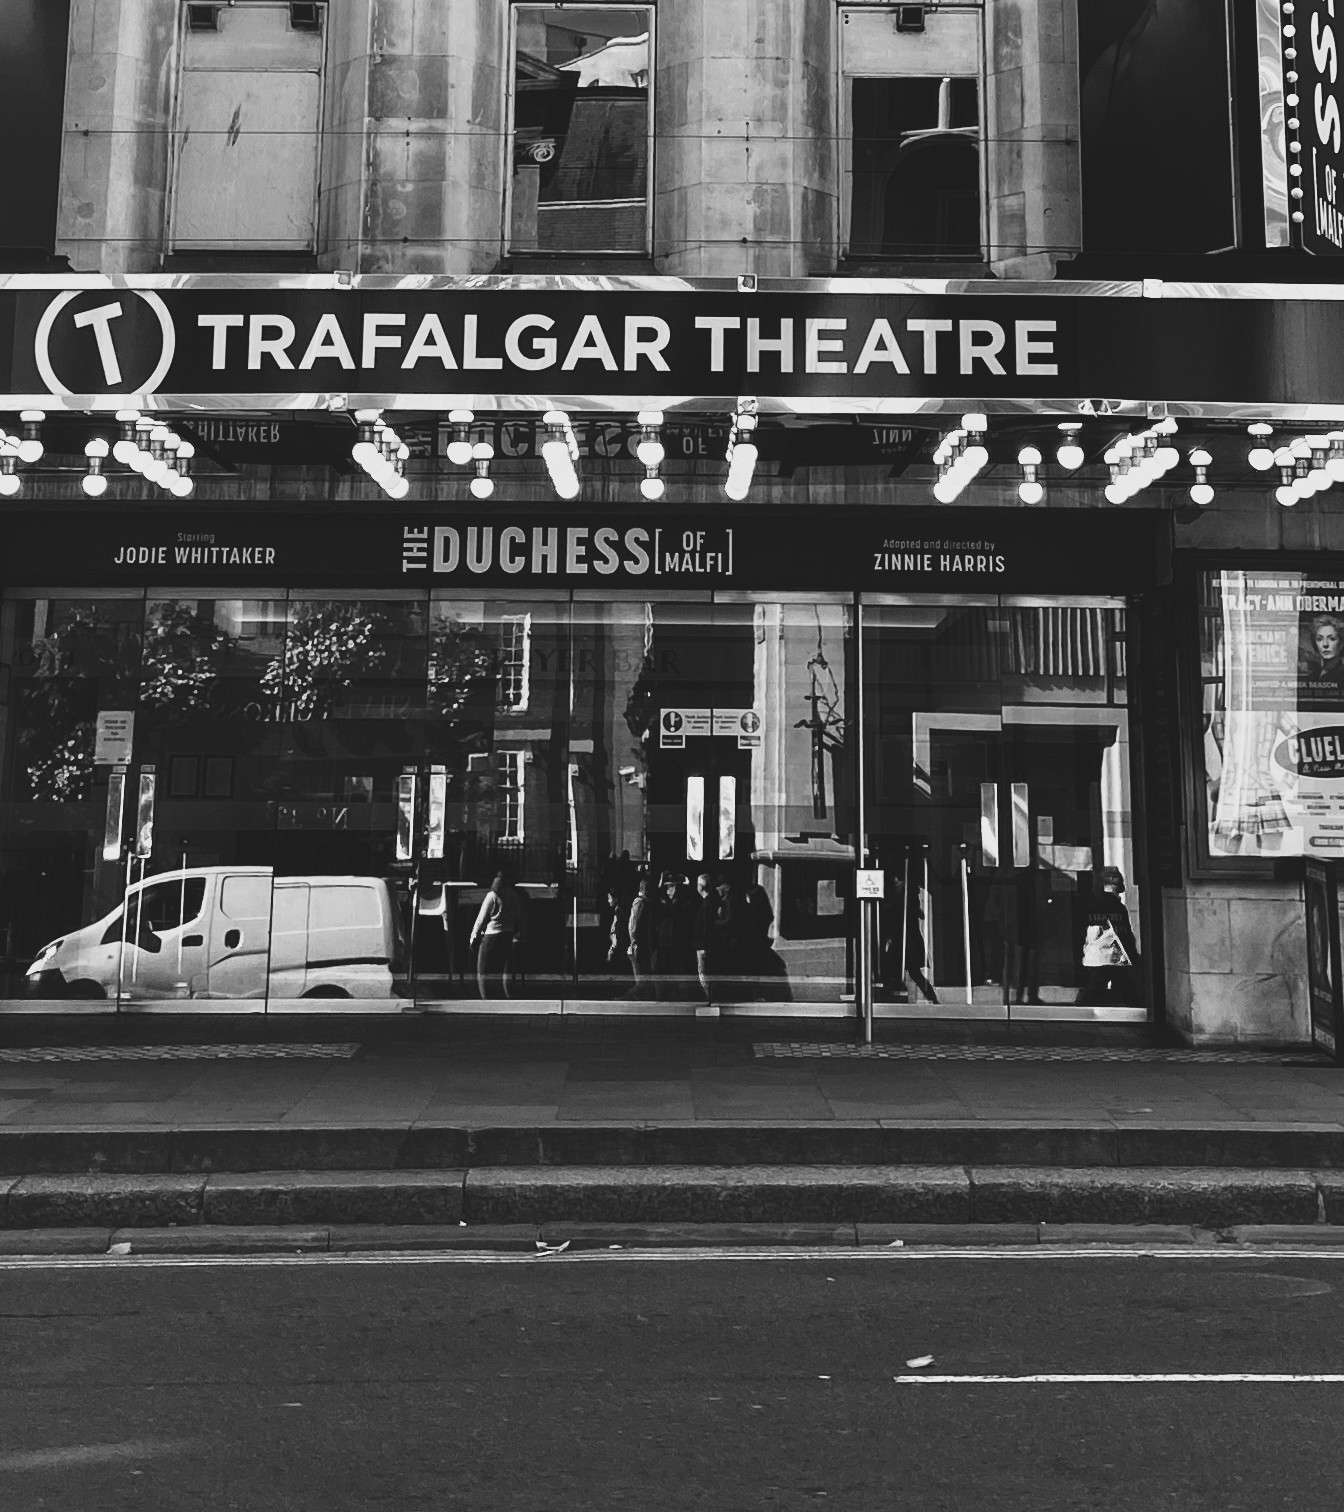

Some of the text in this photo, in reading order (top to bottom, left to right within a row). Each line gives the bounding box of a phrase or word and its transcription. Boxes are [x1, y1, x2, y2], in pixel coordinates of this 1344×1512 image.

[75, 302, 1059, 386] T TRAFALGAR THEATRE
[402, 526, 650, 574] THE DUCHESS
[883, 539, 996, 553] Adapted and directed by
[114, 547, 276, 565] JODIE WHITTAKER
[874, 553, 1005, 572] ZINNIE HARRIS
